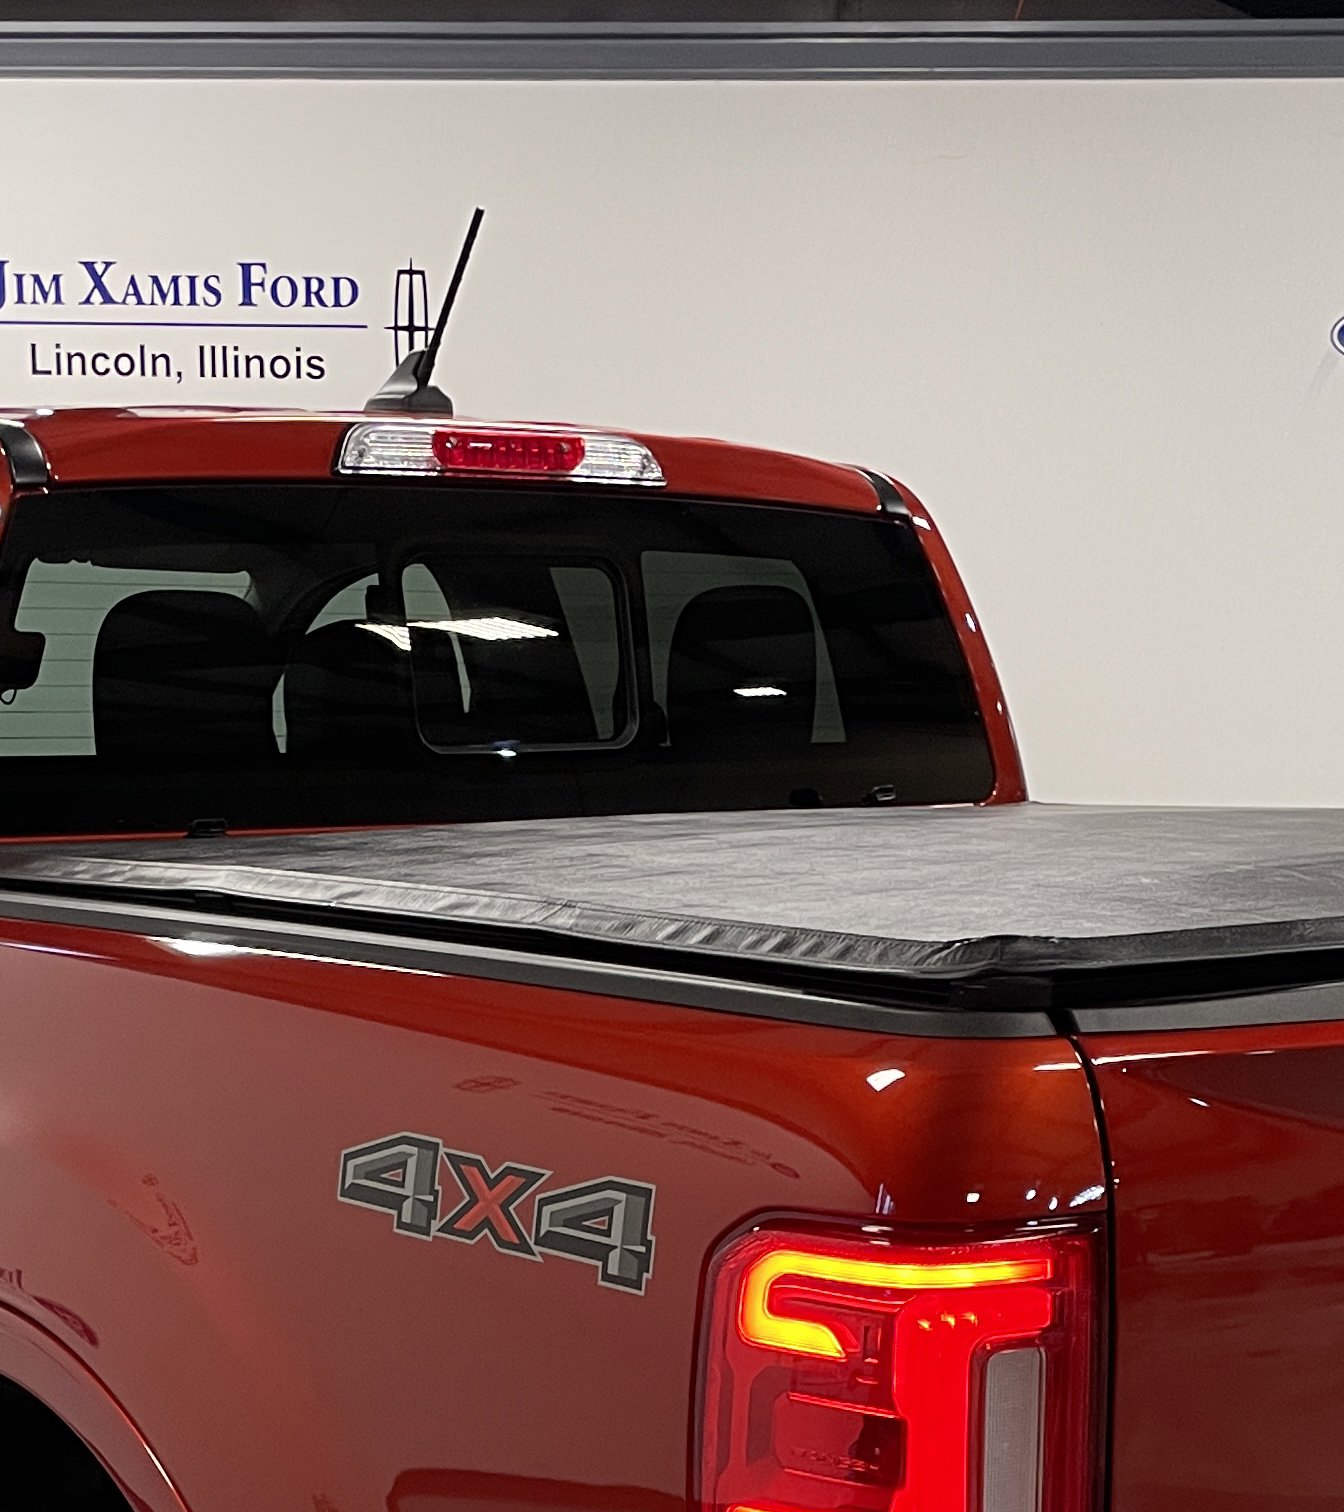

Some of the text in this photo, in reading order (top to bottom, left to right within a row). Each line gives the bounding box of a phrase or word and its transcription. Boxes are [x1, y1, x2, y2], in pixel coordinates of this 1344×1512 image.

[77, 260, 223, 308] XAMIS
[237, 262, 360, 309] FORD
[30, 342, 326, 384] Lincoln, Illinois
